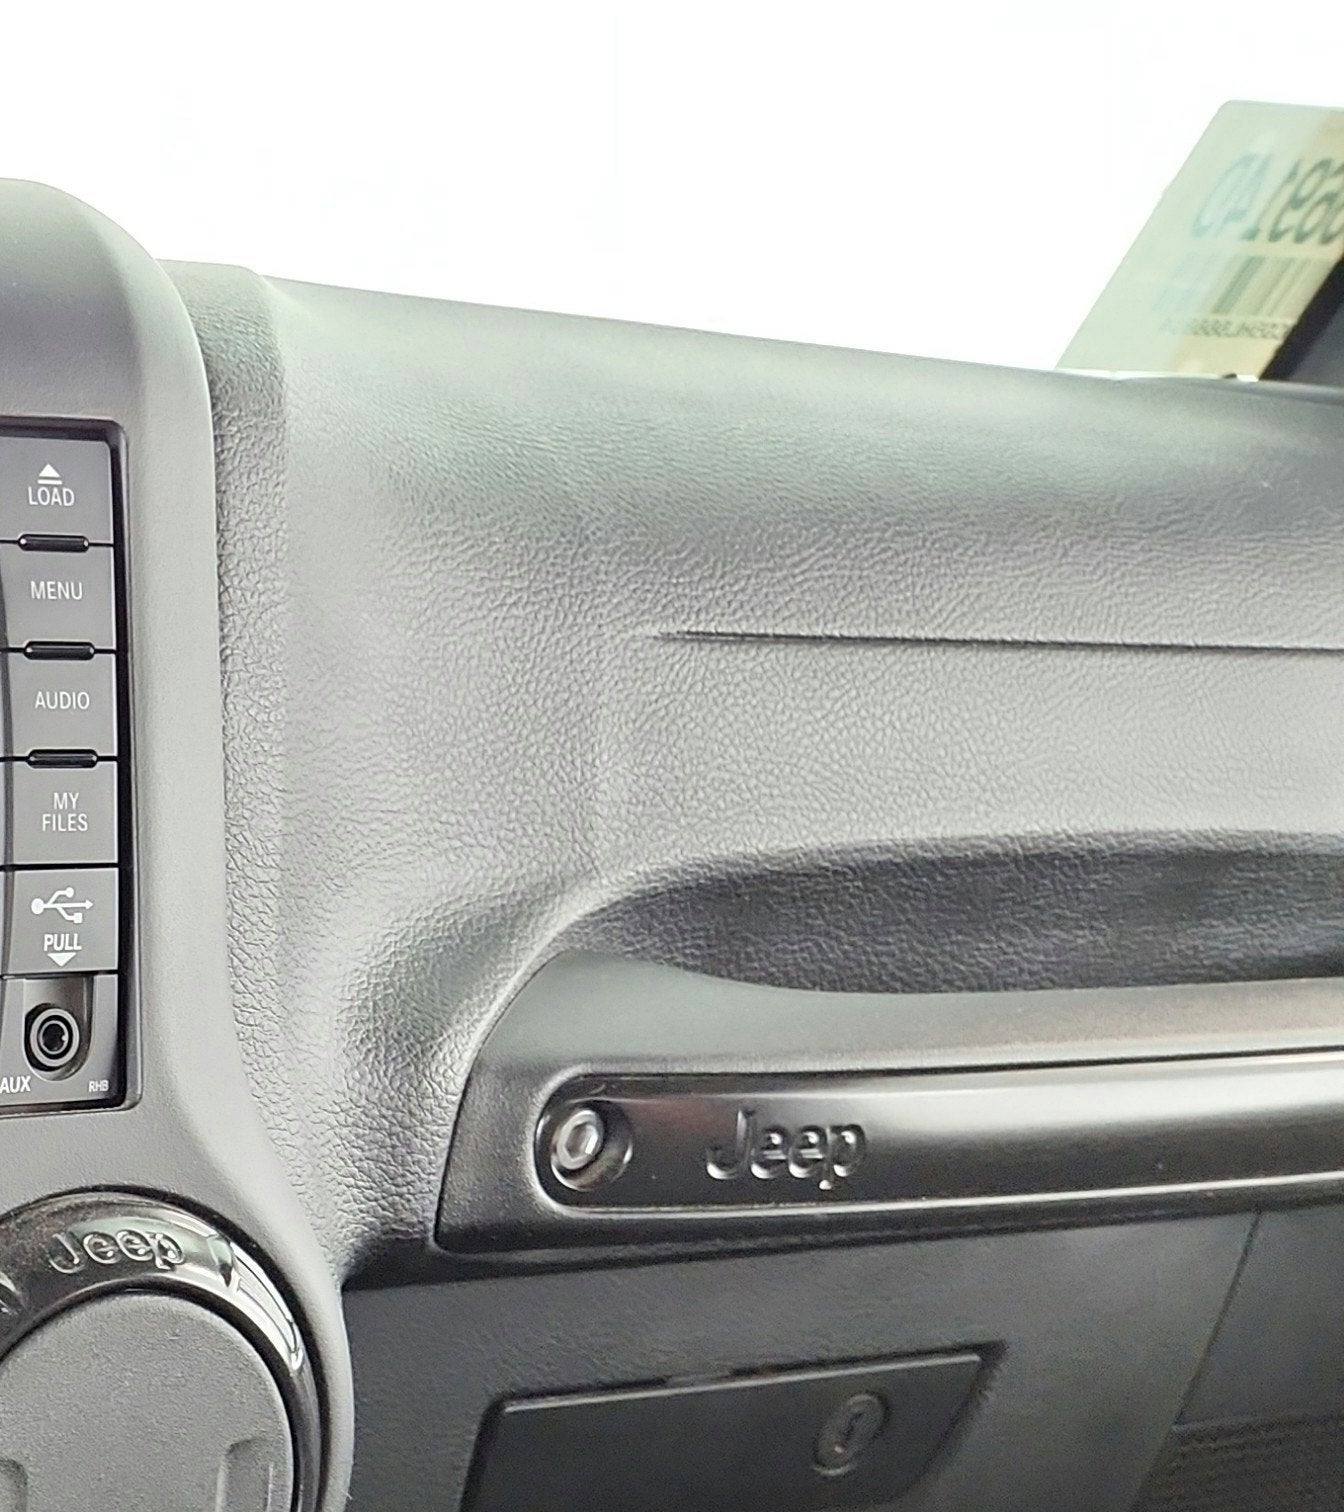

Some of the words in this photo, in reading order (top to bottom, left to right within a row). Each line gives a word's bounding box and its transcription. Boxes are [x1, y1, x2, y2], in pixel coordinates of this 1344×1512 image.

[27, 486, 75, 508] LOAD
[30, 580, 83, 602] MENU
[33, 690, 91, 711] AUDIO
[52, 791, 79, 812] MY
[41, 810, 89, 833] FILES
[43, 932, 83, 953] PULL
[88, 1079, 109, 1093] RHB
[706, 1108, 866, 1190] Jeep
[48, 1228, 185, 1275] Jeep
